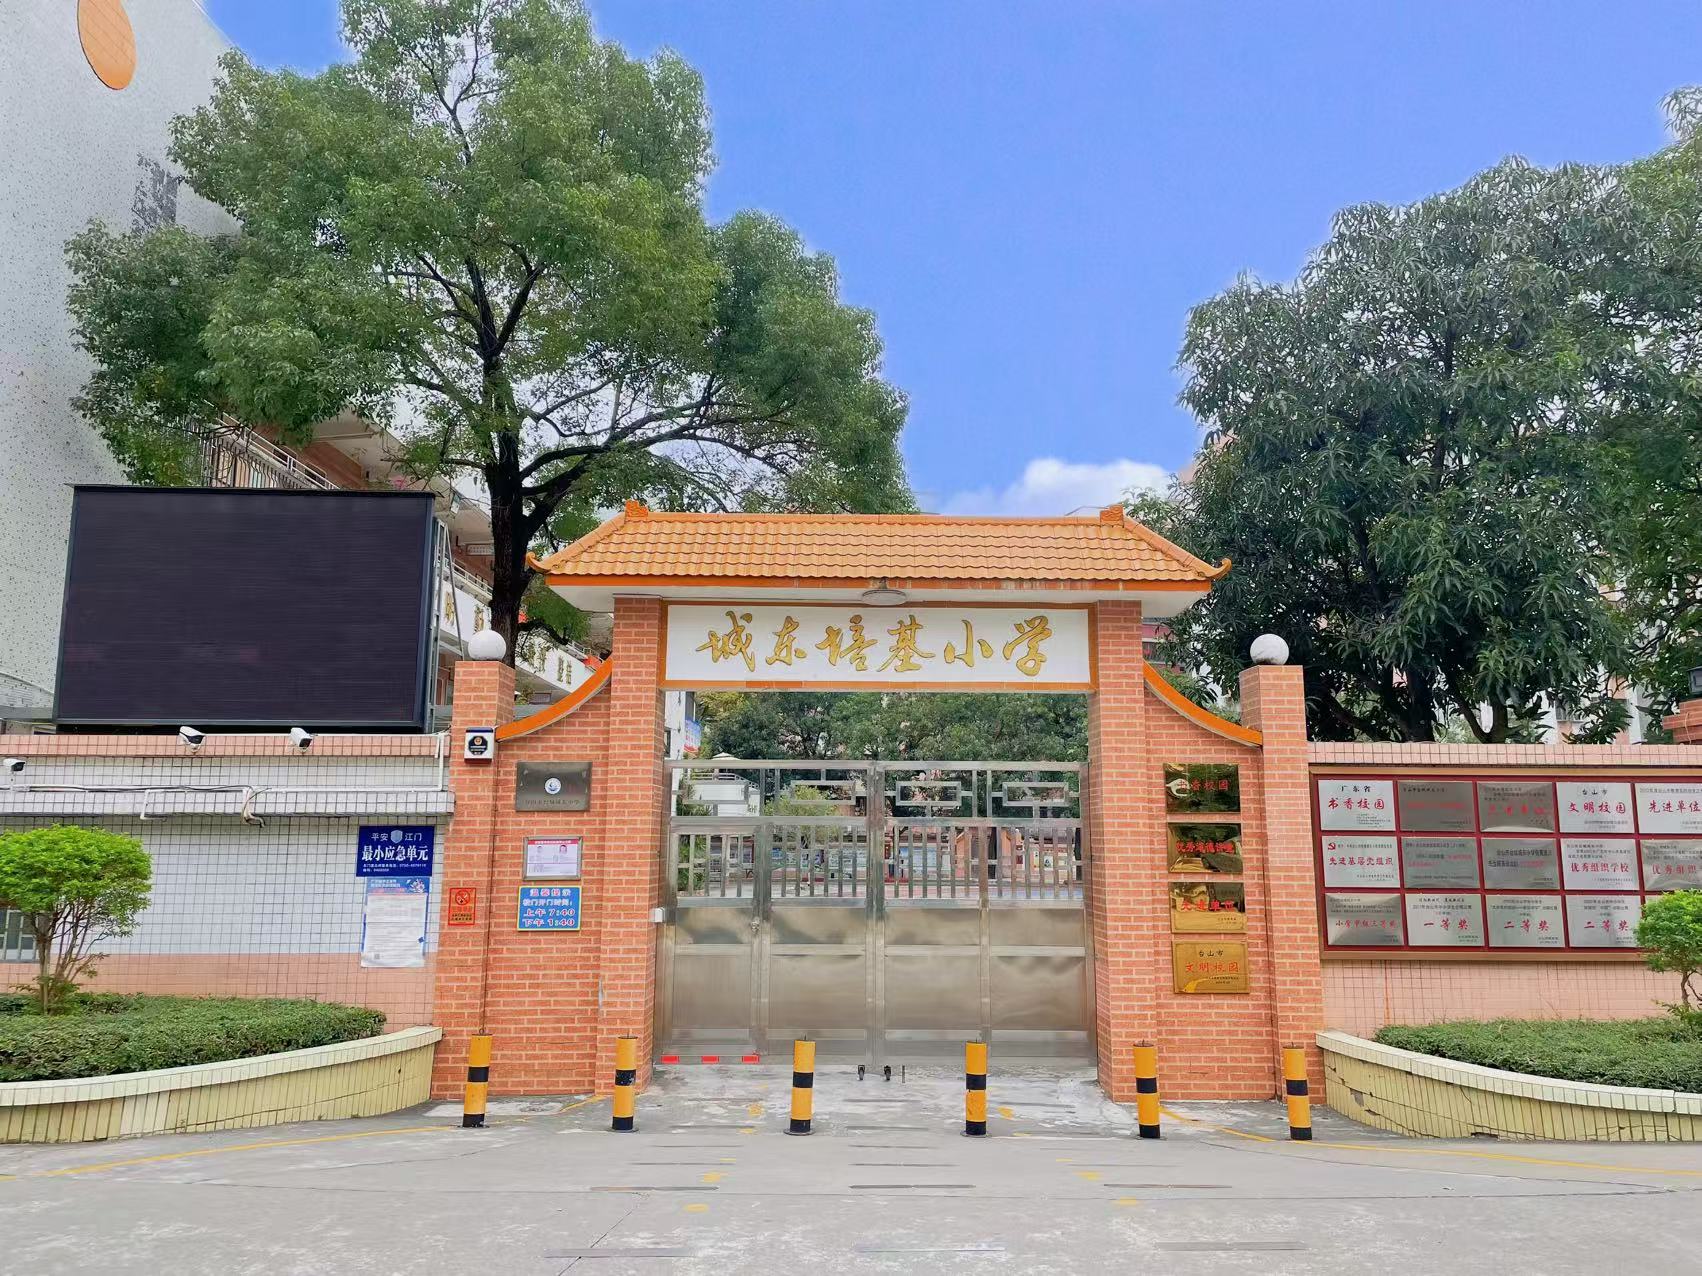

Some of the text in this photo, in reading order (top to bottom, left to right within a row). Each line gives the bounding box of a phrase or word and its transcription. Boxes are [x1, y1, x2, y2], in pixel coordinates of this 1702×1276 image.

[695, 609, 1054, 677] 城东培基小学
[1582, 788, 1607, 796] 台山市
[1328, 797, 1385, 810] 书香校园
[1568, 801, 1626, 814] 文明校园
[1649, 800, 1701, 813] 先进单位
[371, 832, 422, 841] 平安 江门
[361, 844, 429, 861] 最小应急单元
[1328, 856, 1394, 866] 先进基层党组织
[1571, 862, 1629, 873] 优秀组织学校
[523, 908, 546, 917] 上午
[521, 918, 545, 927] 下午
[1423, 918, 1469, 932] 一等奖
[1503, 918, 1549, 933] 二等奖
[1583, 919, 1629, 932] 二等奖
[1185, 961, 1240, 973] 文明校园
